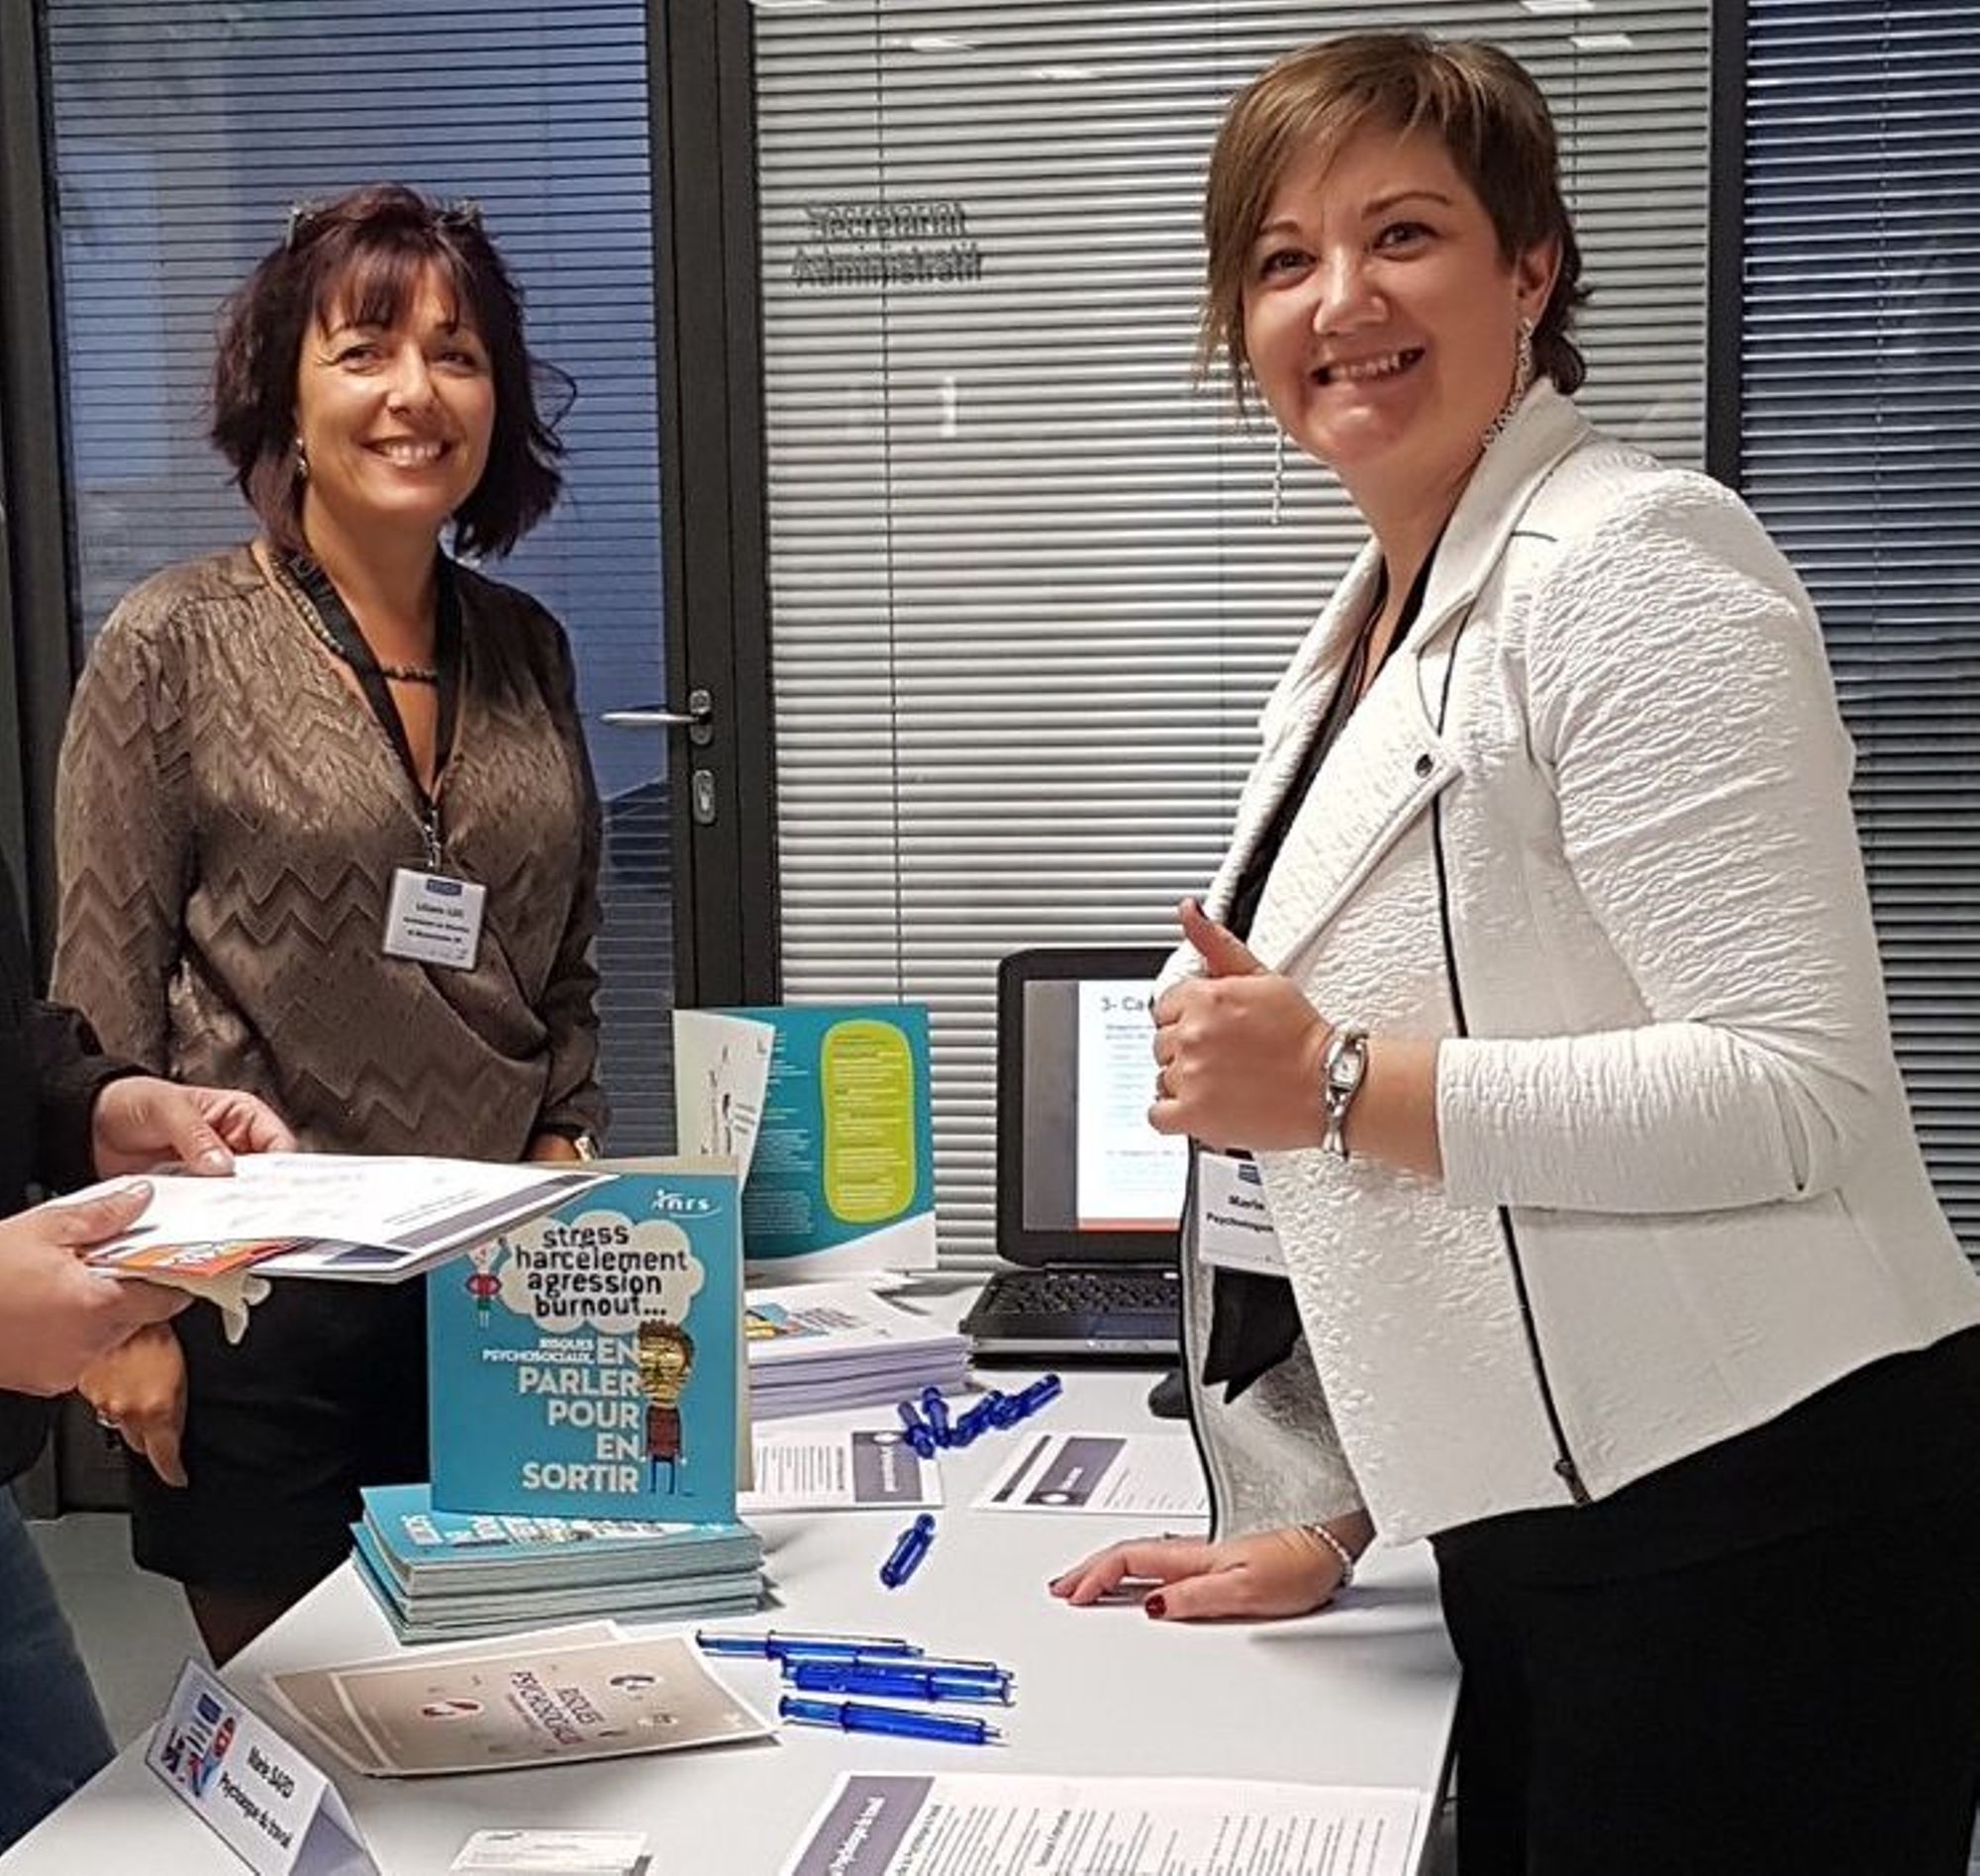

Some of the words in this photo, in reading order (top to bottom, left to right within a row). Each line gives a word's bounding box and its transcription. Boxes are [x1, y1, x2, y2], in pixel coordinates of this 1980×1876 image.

[543, 1226, 631, 1248] stress
[528, 1271, 661, 1299] agression
[535, 1294, 667, 1317] burnout...
[539, 1338, 594, 1352] RISQUES
[597, 1336, 642, 1364] EN
[519, 1365, 642, 1397] PARLER
[548, 1399, 640, 1429] POUR
[596, 1432, 640, 1460] EN
[522, 1462, 640, 1493] SORTIR
